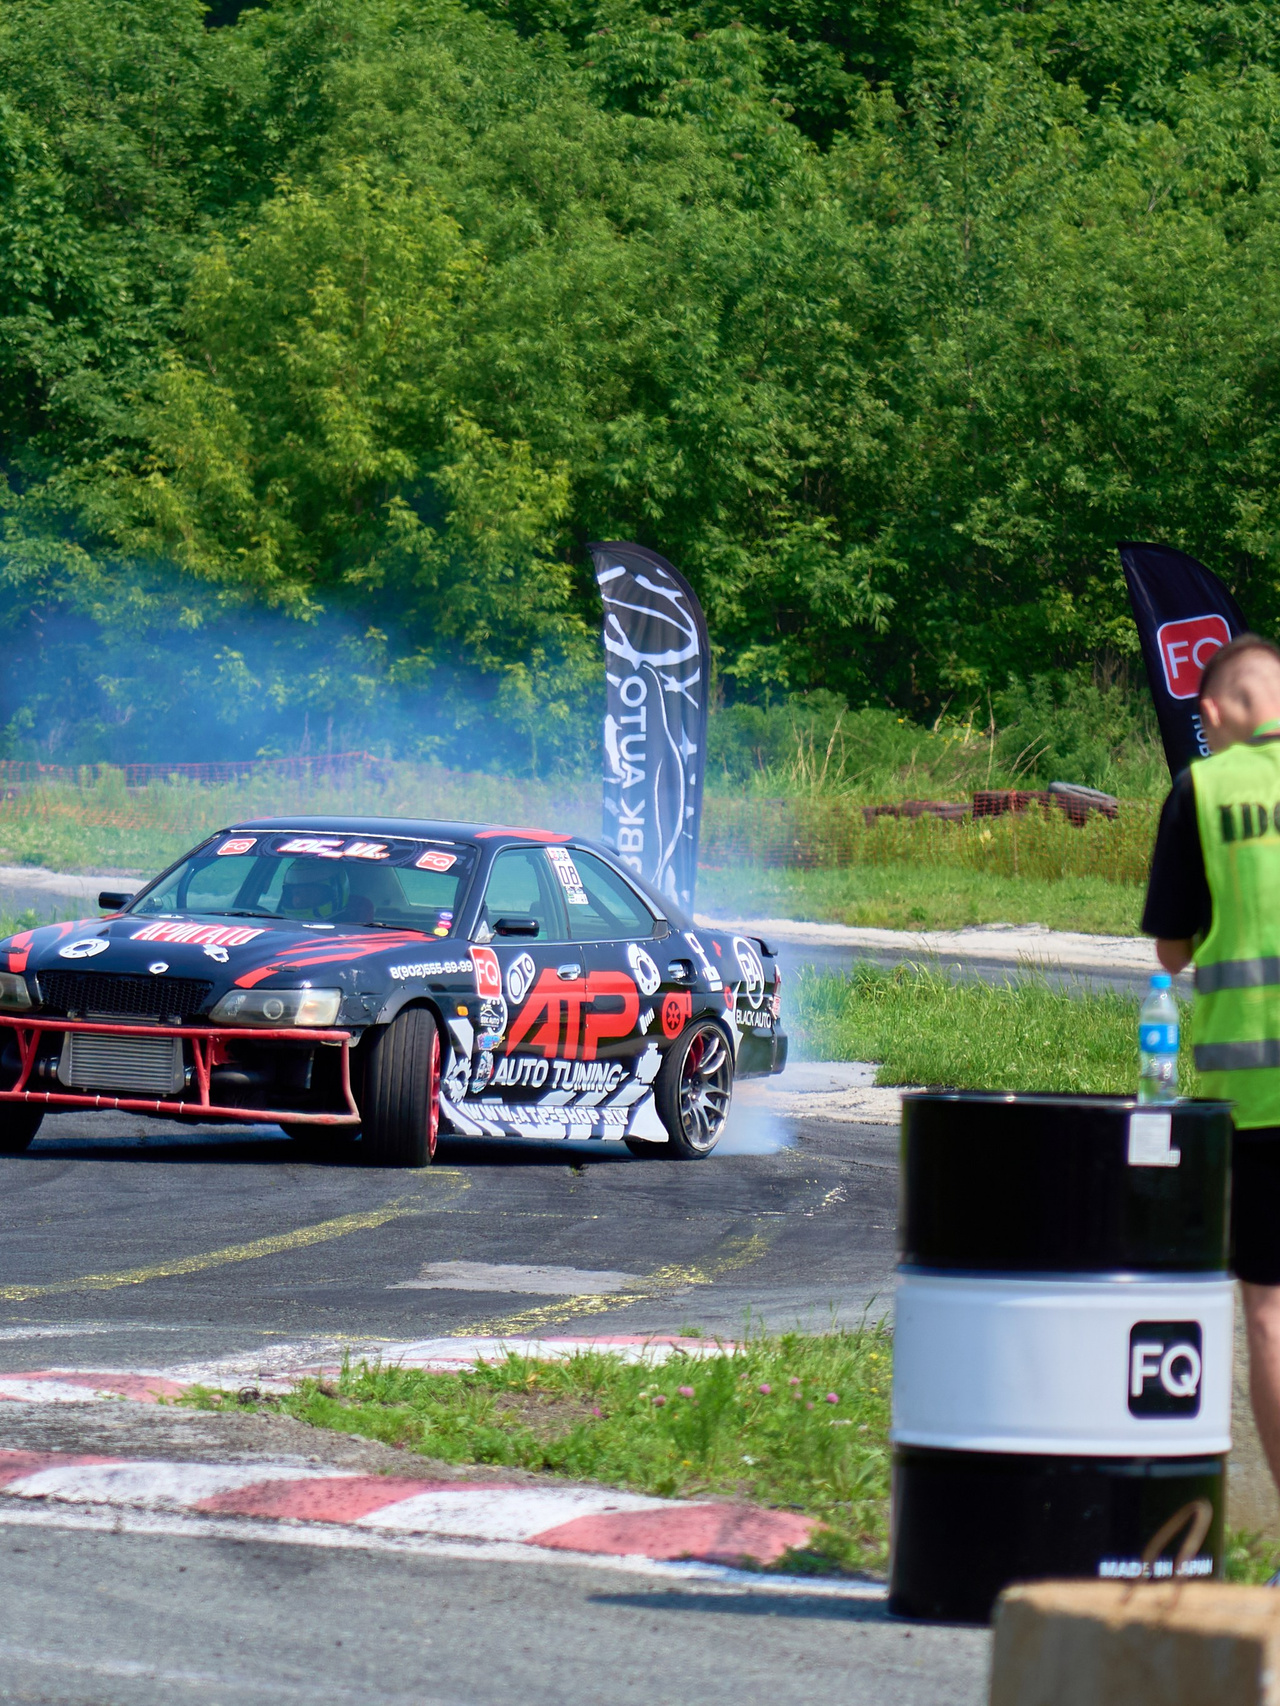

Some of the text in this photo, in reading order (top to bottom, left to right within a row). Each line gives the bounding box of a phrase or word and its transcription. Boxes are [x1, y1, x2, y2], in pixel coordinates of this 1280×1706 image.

[1219, 802, 1280, 843] ID
[225, 841, 252, 852] FQ
[421, 855, 451, 868] FQ
[559, 866, 580, 885] 08
[130, 922, 266, 947] АРИГАТО
[475, 959, 499, 987] FQ
[736, 1009, 772, 1028] BLACK AUTO
[489, 1058, 549, 1089] AUTO
[551, 1060, 626, 1092] TUNING
[1131, 1343, 1202, 1398] FQ
[1153, 1560, 1173, 1578] IN
